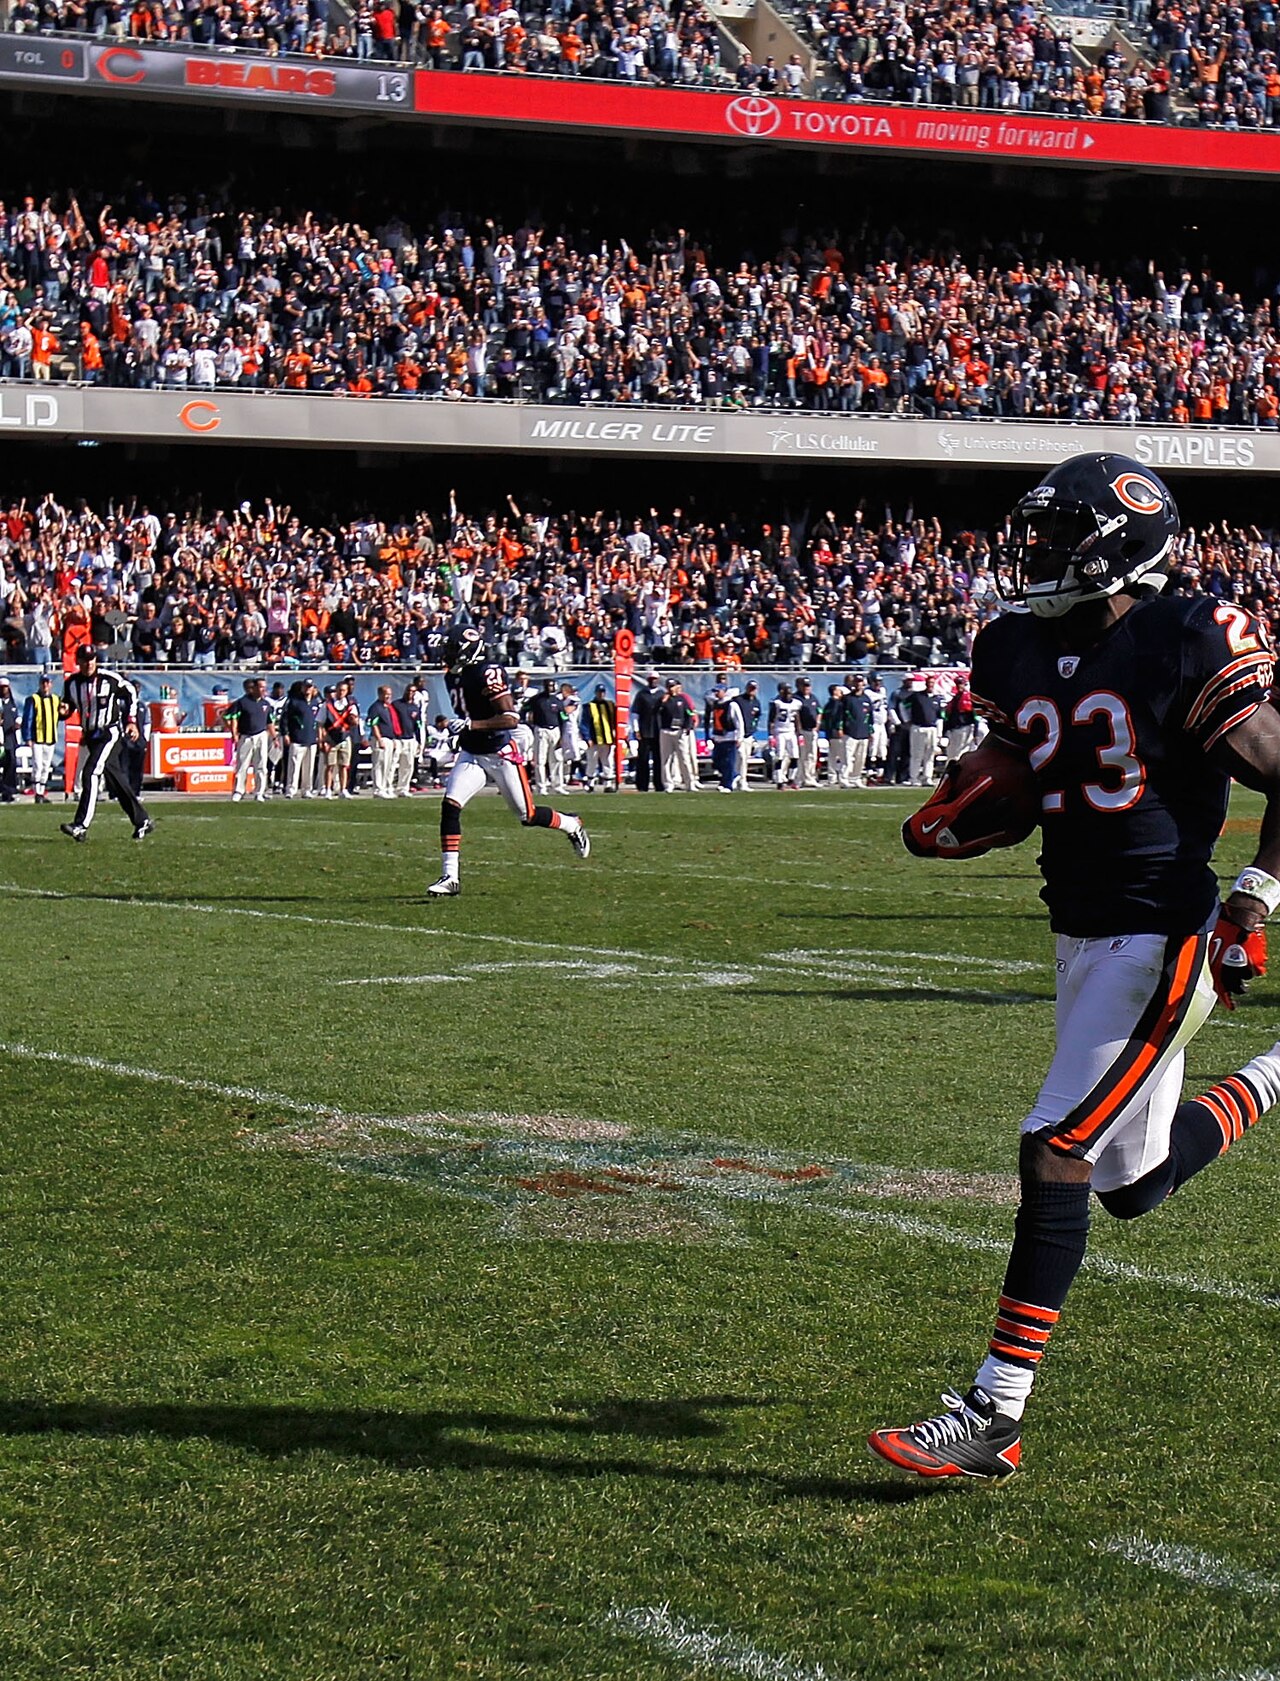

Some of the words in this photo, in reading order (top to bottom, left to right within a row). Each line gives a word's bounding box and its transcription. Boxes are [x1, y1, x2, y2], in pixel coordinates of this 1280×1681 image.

[15, 51, 44, 64] TOL
[185, 58, 336, 96] BEARS
[376, 74, 407, 101] 13
[790, 111, 892, 137] TOYOTA
[915, 119, 990, 148] moving
[997, 121, 1076, 150] forward
[531, 419, 641, 441] MILLER
[651, 424, 715, 443] LITE
[820, 433, 879, 451] Cellular
[963, 436, 1021, 455] University
[1023, 438, 1037, 452] of
[1039, 439, 1085, 453] Phoenix
[1134, 434, 1255, 467] STAPLES
[484, 667, 504, 685] 21
[1015, 689, 1148, 813] 23
